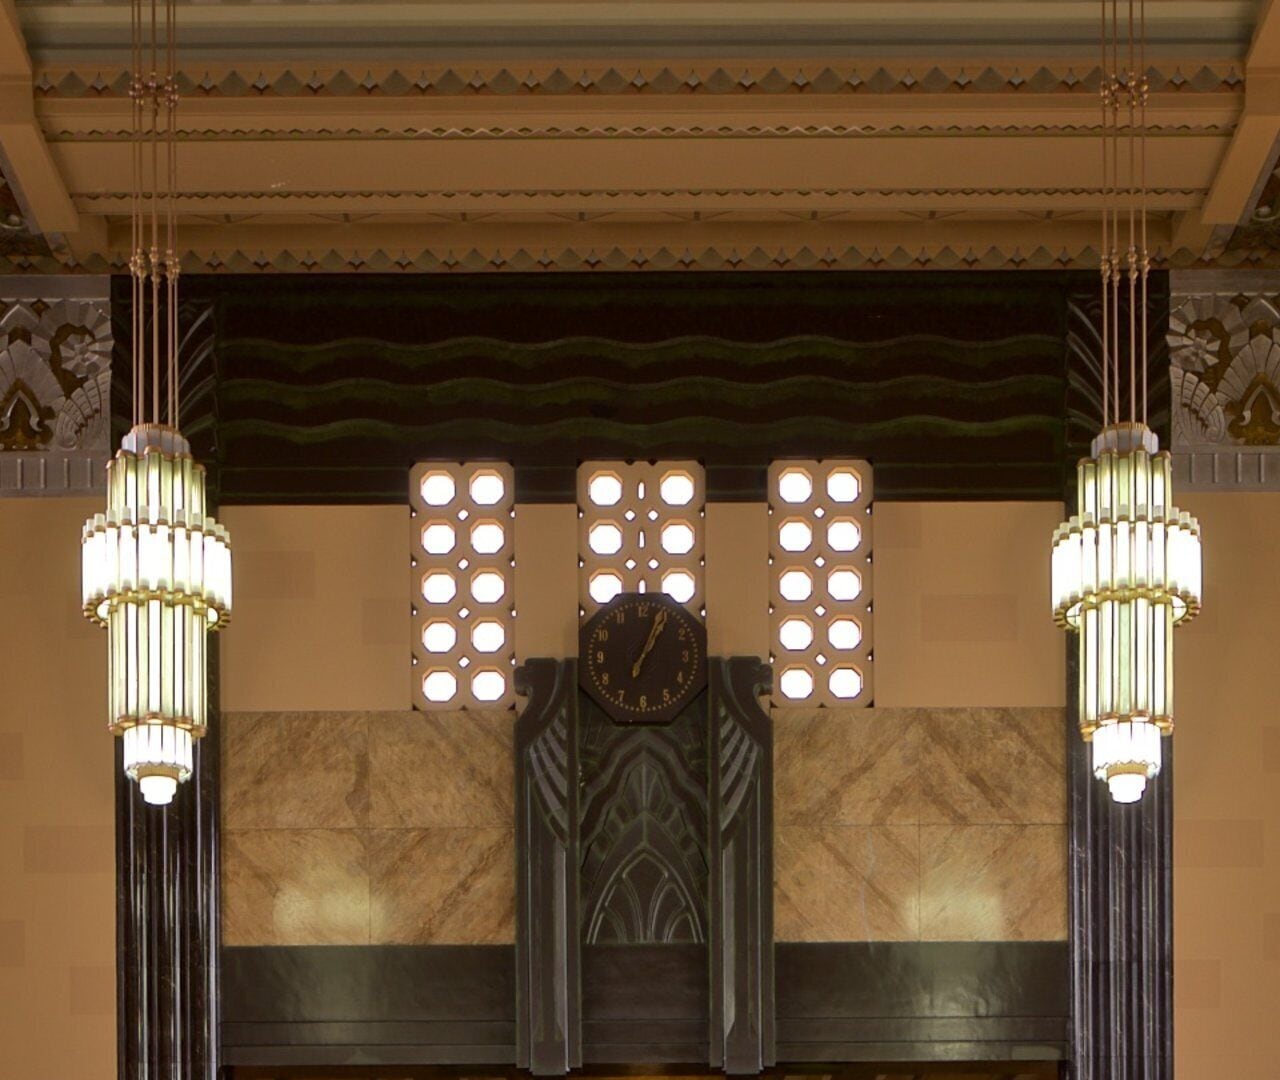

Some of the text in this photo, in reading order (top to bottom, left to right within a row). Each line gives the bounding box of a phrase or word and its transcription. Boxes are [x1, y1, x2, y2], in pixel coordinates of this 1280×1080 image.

[616, 611, 625, 624] 11
[638, 605, 649, 618] 12
[599, 628, 609, 641] 10
[678, 627, 687, 640] 2
[596, 650, 605, 663] 9
[682, 649, 689, 663] 3
[601, 672, 610, 685] 8
[677, 670, 684, 683] 4
[617, 689, 626, 702] 7
[663, 688, 671, 702] 5
[639, 695, 648, 709] 6
